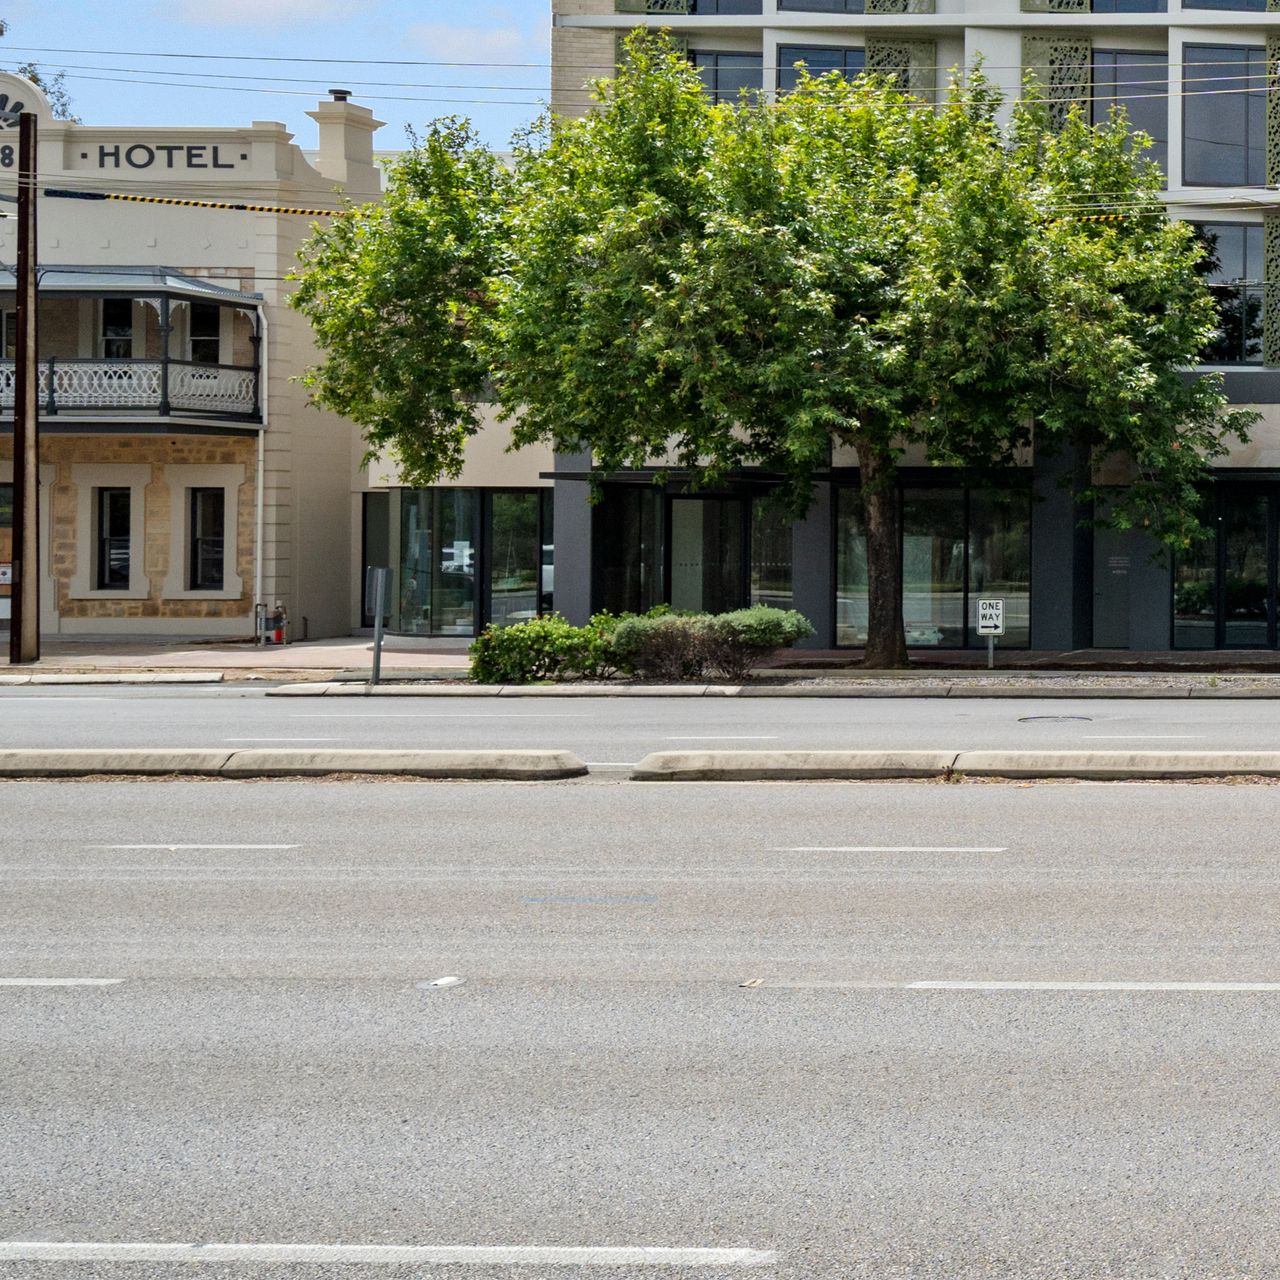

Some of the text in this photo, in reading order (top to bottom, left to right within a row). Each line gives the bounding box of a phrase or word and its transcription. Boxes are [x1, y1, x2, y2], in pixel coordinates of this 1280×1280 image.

[98, 144, 235, 169] HOTEL
[982, 602, 1000, 610] ONE
[981, 613, 1000, 621] WAY
